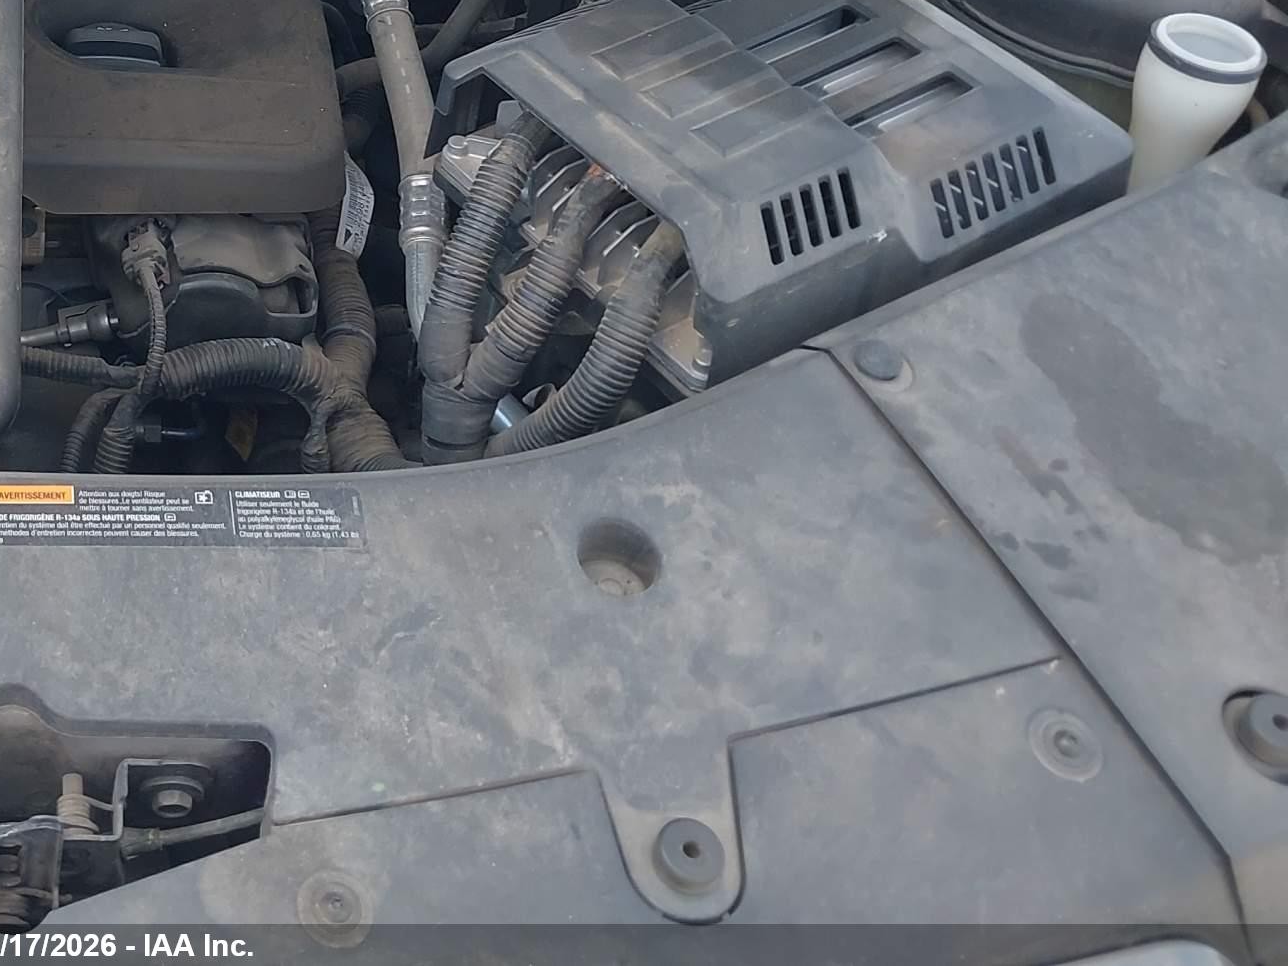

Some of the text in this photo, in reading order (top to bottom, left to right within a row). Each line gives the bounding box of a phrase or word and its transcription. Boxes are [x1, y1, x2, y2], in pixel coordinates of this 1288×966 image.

[28, 522, 56, 530] système
[166, 522, 190, 530] qualifié
[240, 531, 263, 539] Charge
